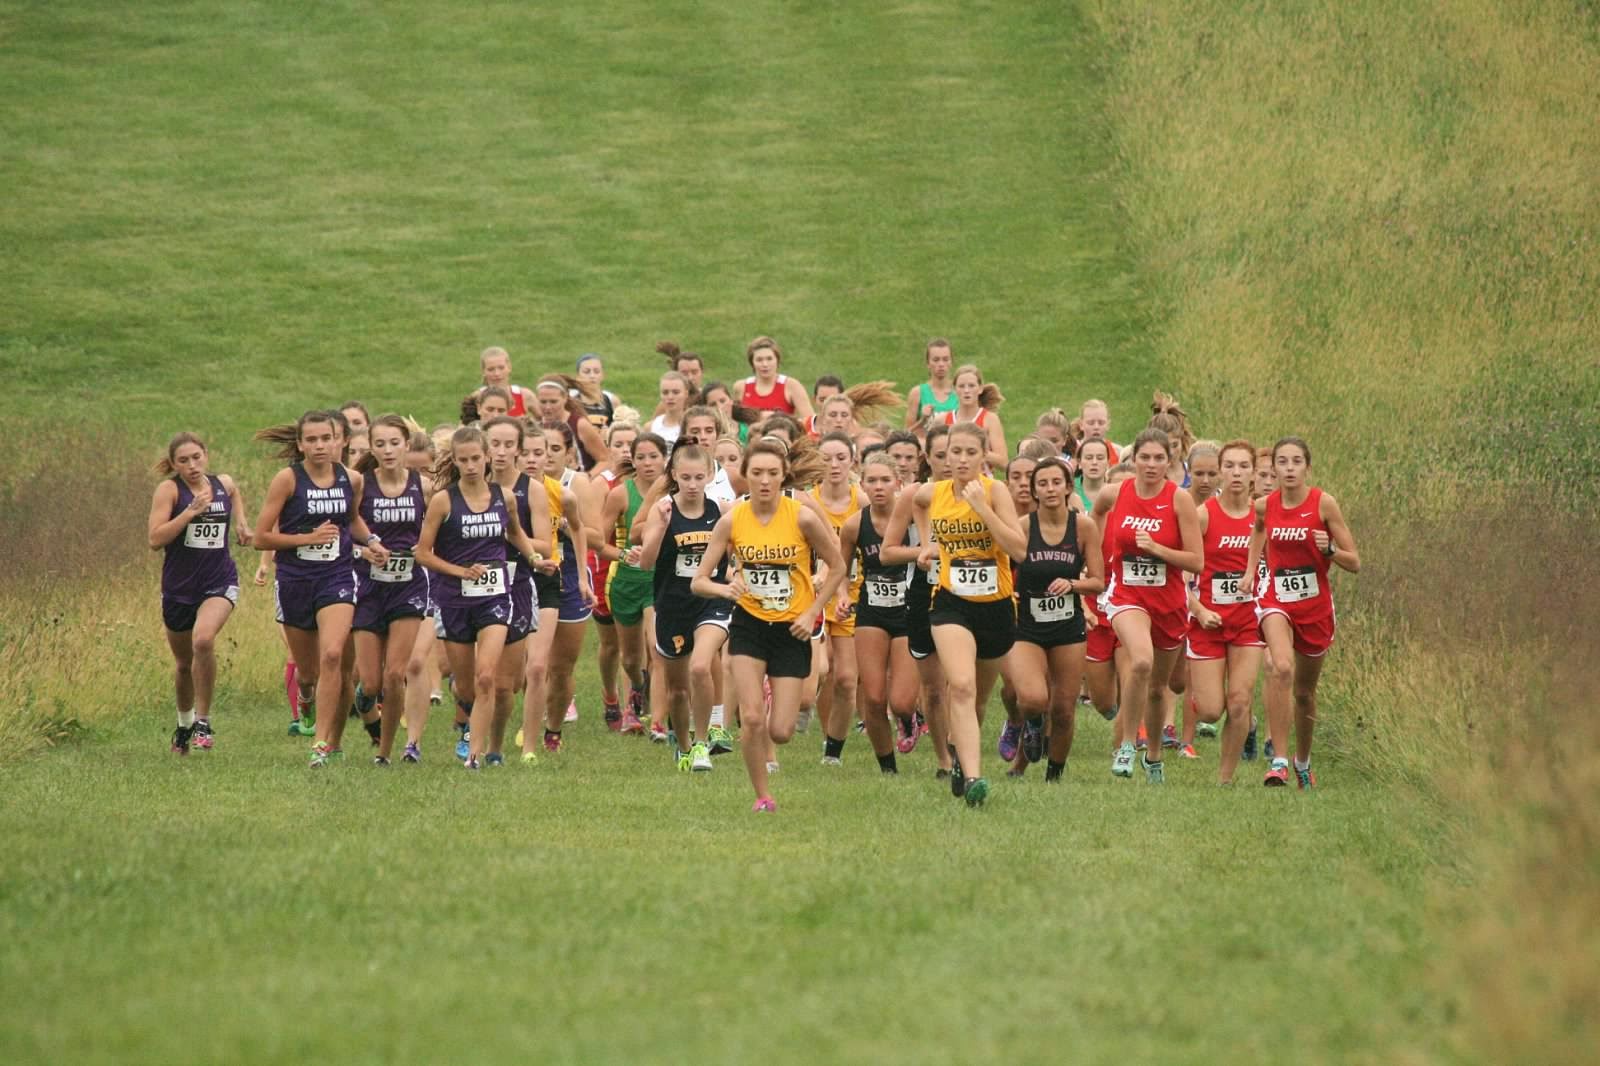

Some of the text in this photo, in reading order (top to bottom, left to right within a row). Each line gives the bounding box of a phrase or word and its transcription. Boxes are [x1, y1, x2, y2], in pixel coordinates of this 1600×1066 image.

[306, 488, 345, 499] PARK HILL
[307, 499, 347, 514] SOUTH
[373, 496, 415, 508] PARK HILL
[373, 508, 416, 523] SOUTH
[461, 511, 501, 525] PARK HILL
[1121, 515, 1163, 532] PHHS
[194, 524, 220, 538] 503
[461, 523, 502, 539] SOUTH
[1270, 527, 1309, 541] PHHS
[1218, 535, 1251, 549] PHH
[1030, 550, 1075, 564] LAWSON
[958, 568, 988, 584] 376
[1131, 563, 1158, 576] 473
[750, 570, 780, 586] 374
[1282, 576, 1309, 592] 461
[873, 582, 899, 597] 395
[1220, 580, 1238, 594] 46
[1038, 596, 1065, 612] 400
